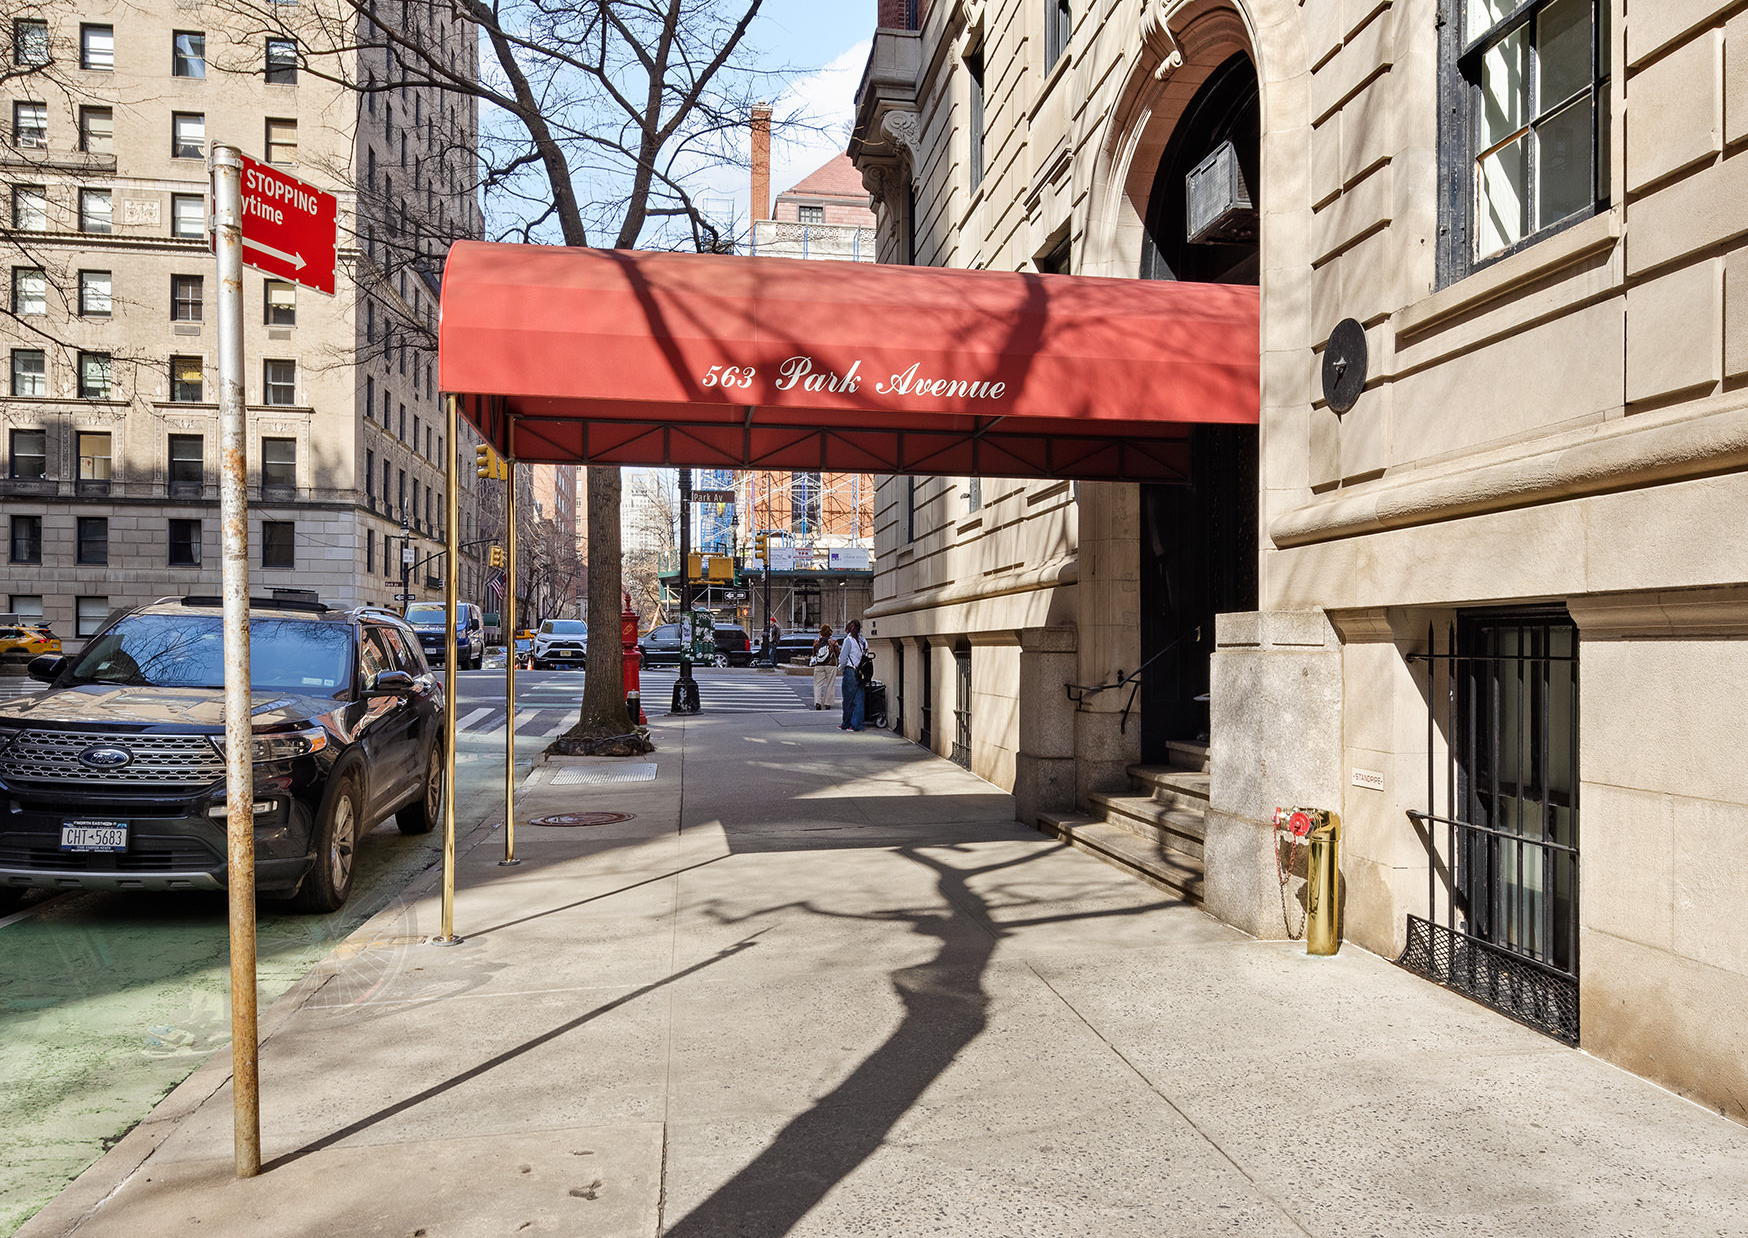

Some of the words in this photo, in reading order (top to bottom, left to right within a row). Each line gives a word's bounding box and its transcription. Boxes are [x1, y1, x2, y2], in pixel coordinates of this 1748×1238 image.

[246, 168, 318, 216] STOPPING
[702, 364, 756, 389] 563
[775, 356, 862, 394] Park
[875, 362, 1006, 399] Avenue
[693, 493, 711, 502] Park
[713, 493, 724, 502] Av
[91, 751, 117, 764] Ford
[1356, 772, 1380, 784] STANDPIPE
[95, 829, 123, 846] 5683
